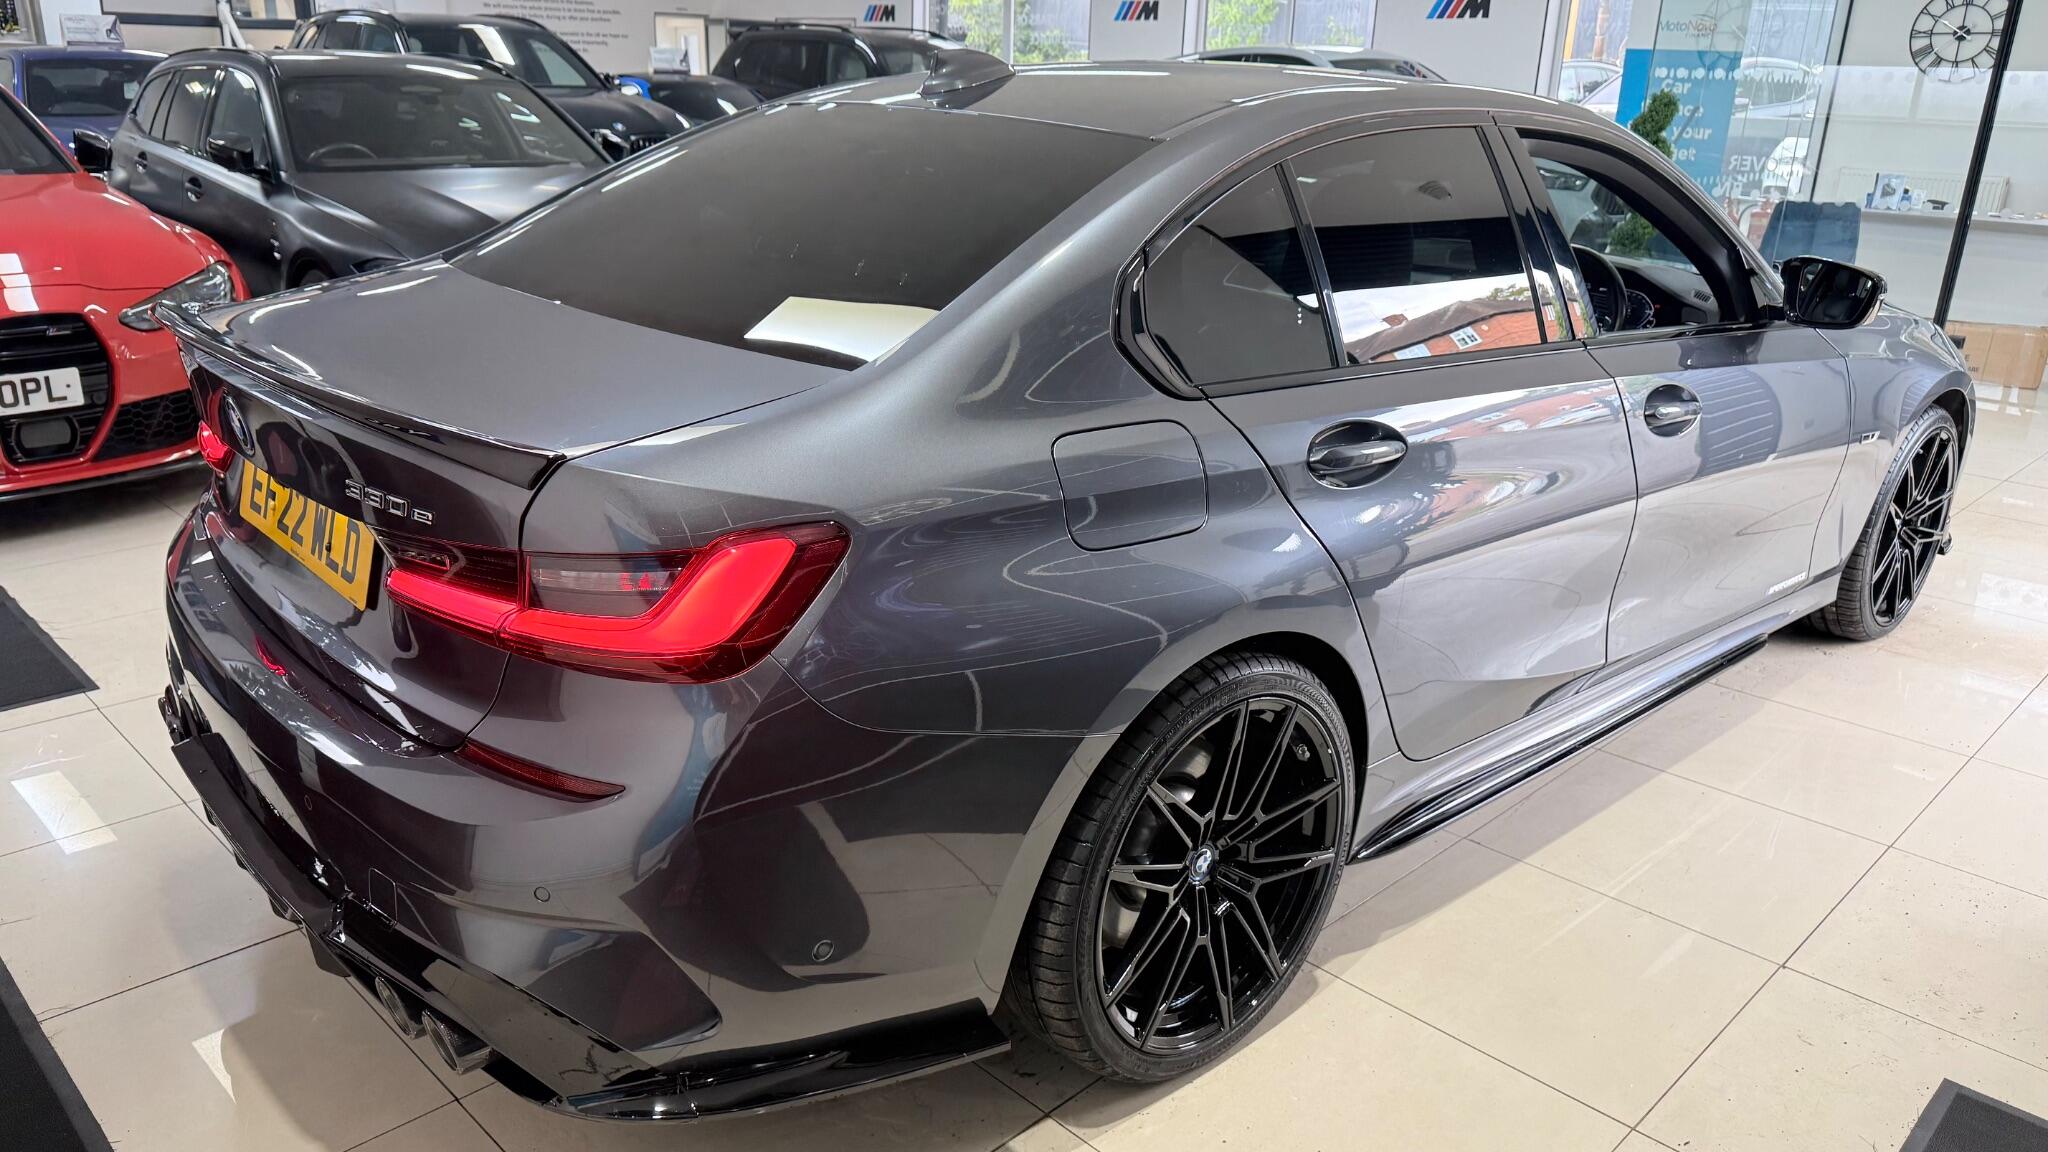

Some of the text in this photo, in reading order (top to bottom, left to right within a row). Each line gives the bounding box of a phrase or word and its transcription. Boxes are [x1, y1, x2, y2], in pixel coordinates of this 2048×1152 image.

[1661, 79, 1692, 94] Car
[1671, 126, 1712, 141] your
[249, 465, 360, 584] EF22 WLD
